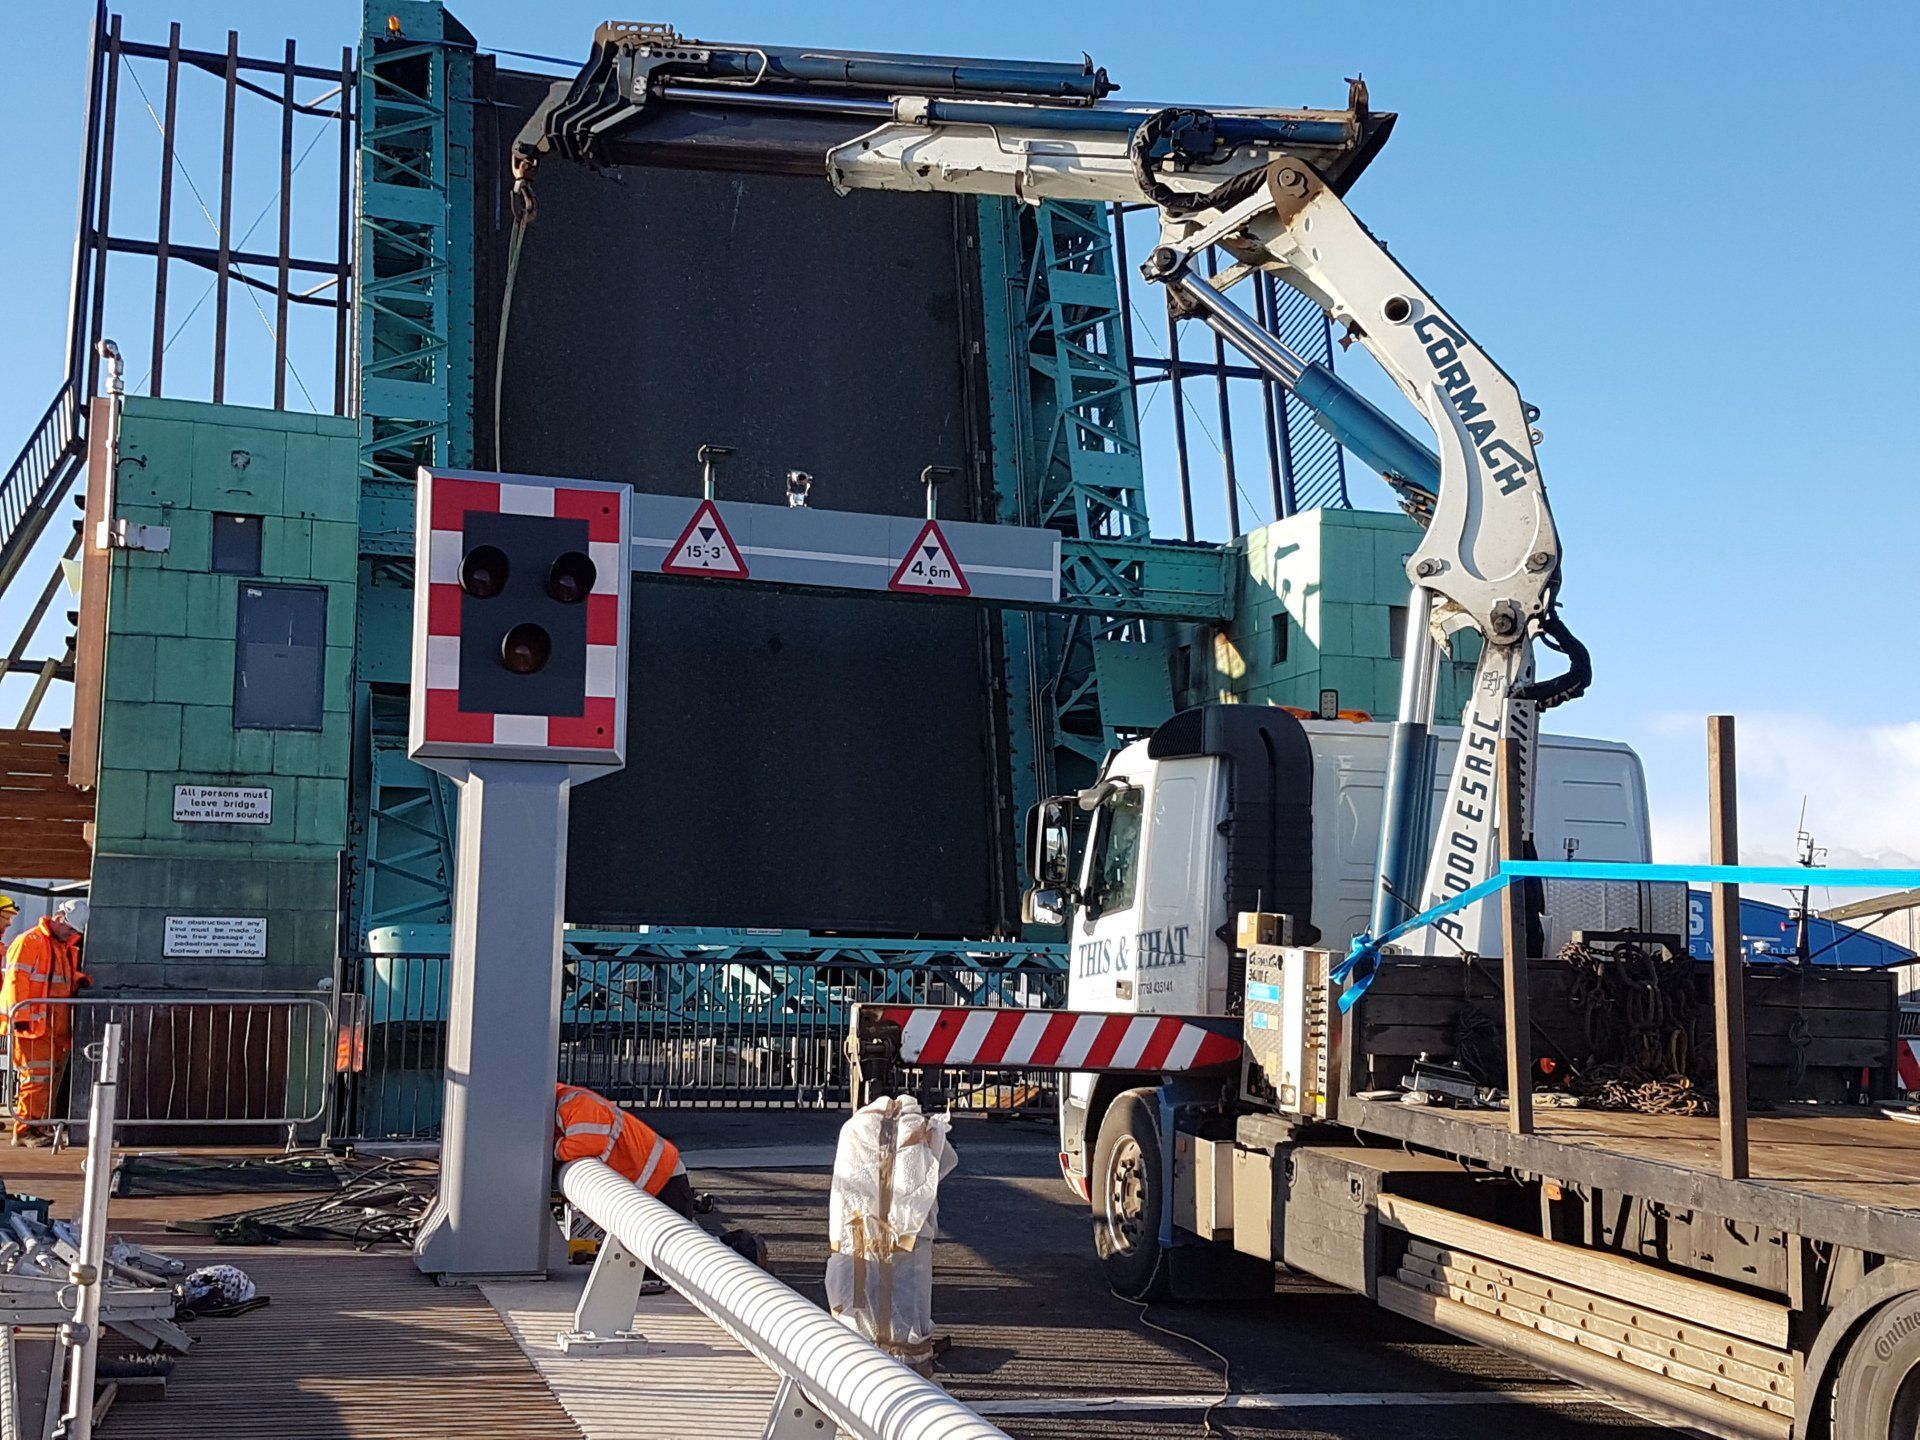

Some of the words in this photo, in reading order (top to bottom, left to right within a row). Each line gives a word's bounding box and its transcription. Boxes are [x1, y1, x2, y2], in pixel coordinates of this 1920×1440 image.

[1413, 314, 1535, 497] CORMACH
[911, 561, 950, 578] 4.6m
[180, 788, 196, 797] All
[200, 790, 240, 798] persons
[243, 790, 268, 799] must
[191, 799, 218, 807] leave
[223, 800, 256, 809] bridge
[175, 809, 202, 817] when
[204, 809, 234, 818] alarm
[236, 811, 269, 819] sounds
[1079, 938, 1112, 980] THIS
[1115, 936, 1129, 972] &
[1135, 925, 1189, 970] THAT
